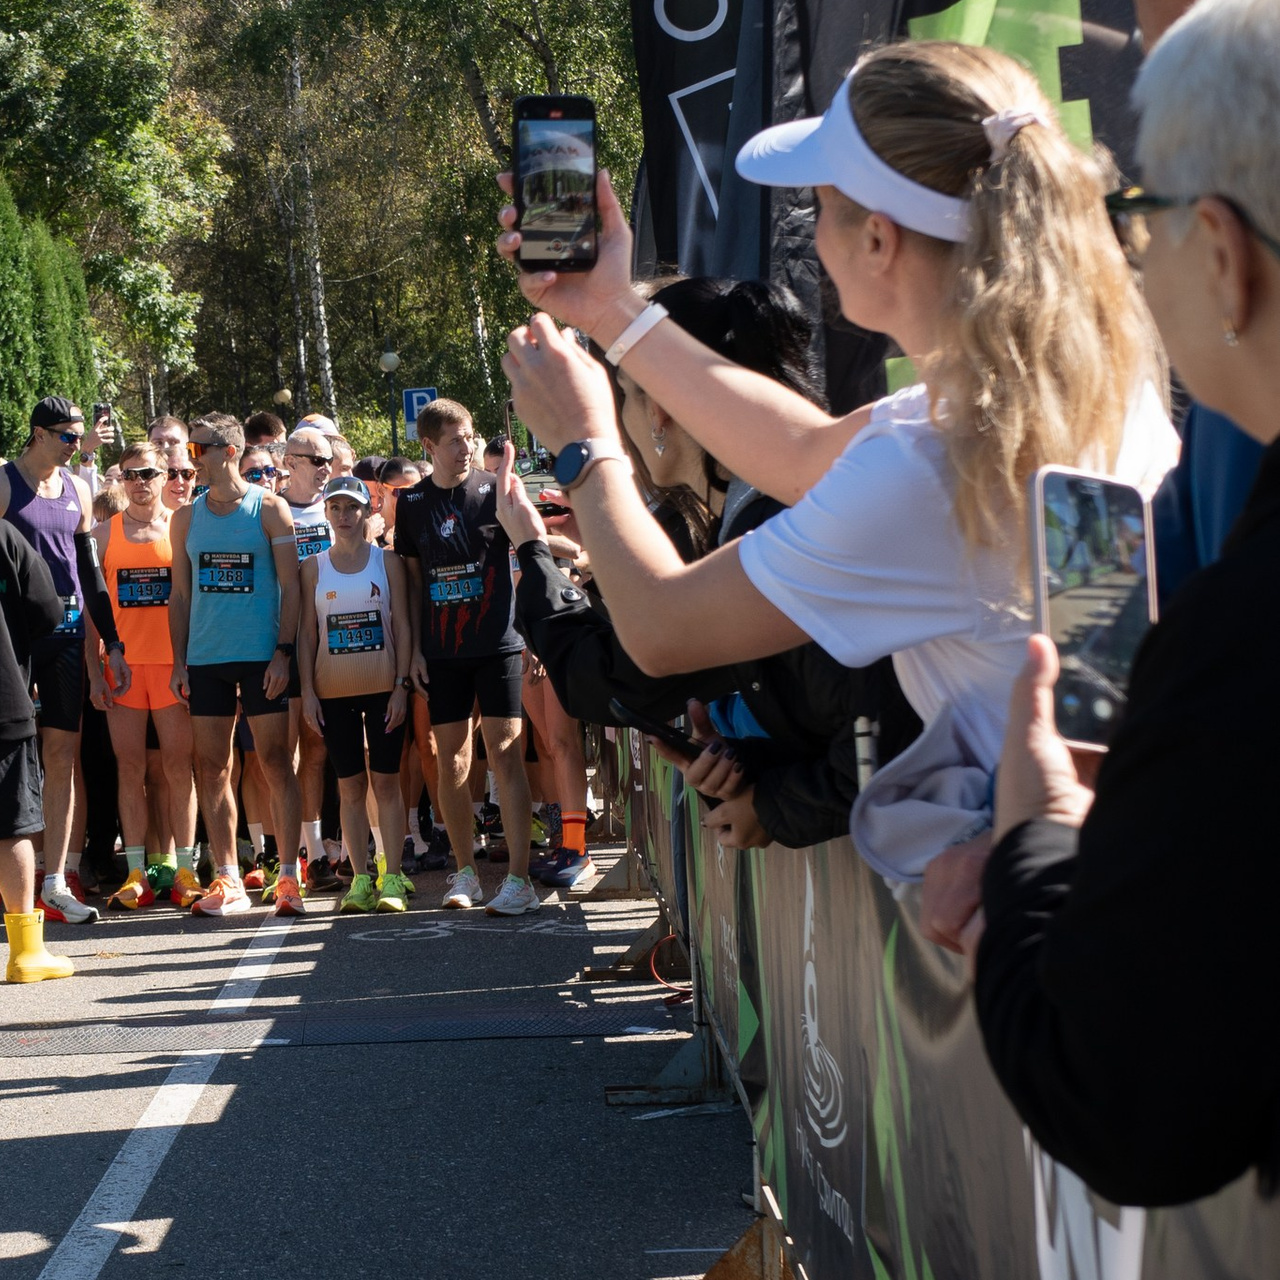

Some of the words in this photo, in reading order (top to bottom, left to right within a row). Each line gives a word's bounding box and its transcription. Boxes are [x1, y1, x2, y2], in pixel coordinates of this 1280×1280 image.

[209, 569, 243, 582] 1268
[128, 582, 163, 597] 1492
[437, 580, 472, 597] 1214
[337, 628, 374, 644] 1449
